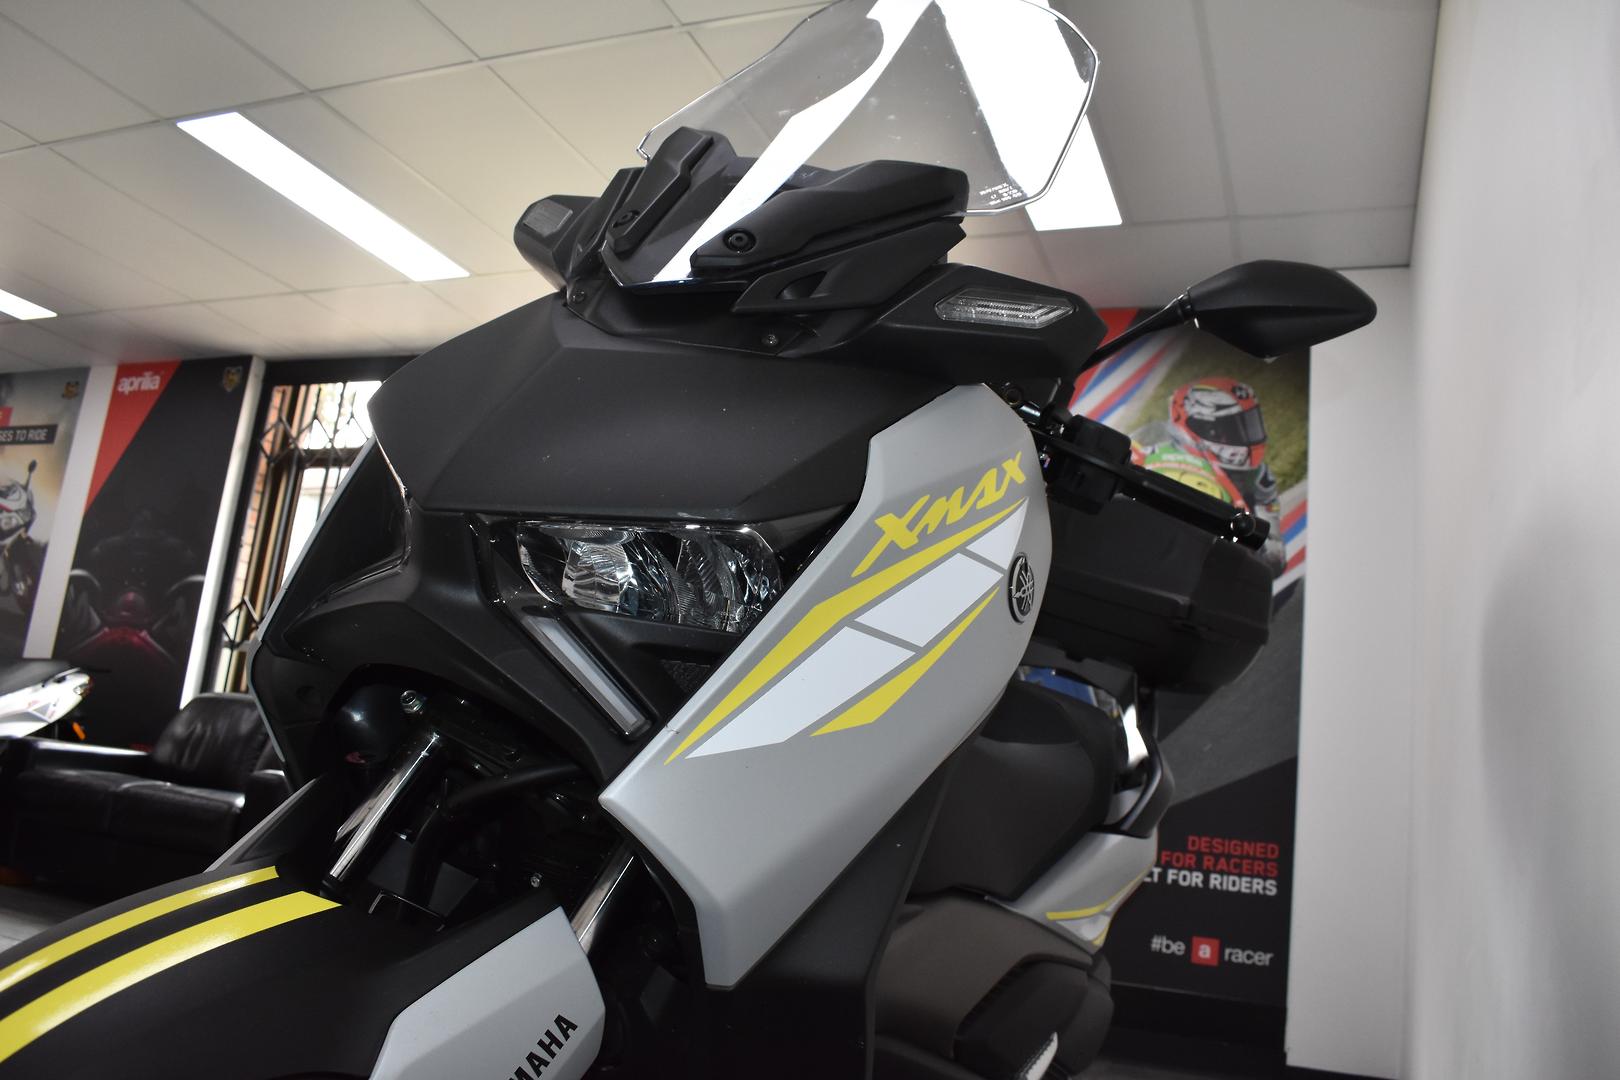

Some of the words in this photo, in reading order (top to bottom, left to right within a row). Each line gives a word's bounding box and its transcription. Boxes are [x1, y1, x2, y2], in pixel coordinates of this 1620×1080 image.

[118, 372, 161, 394] aprilia
[16, 429, 27, 441] TO
[28, 428, 48, 441] RIDE
[1188, 836, 1279, 859] DESIGNED
[1161, 851, 1196, 868] FOR
[1203, 856, 1278, 876] RACERS
[1168, 869, 1203, 888] FOR
[1210, 876, 1277, 896] RIDERS
[1151, 935, 1185, 955] #be
[1198, 944, 1211, 958] a
[1224, 948, 1273, 966] racer
